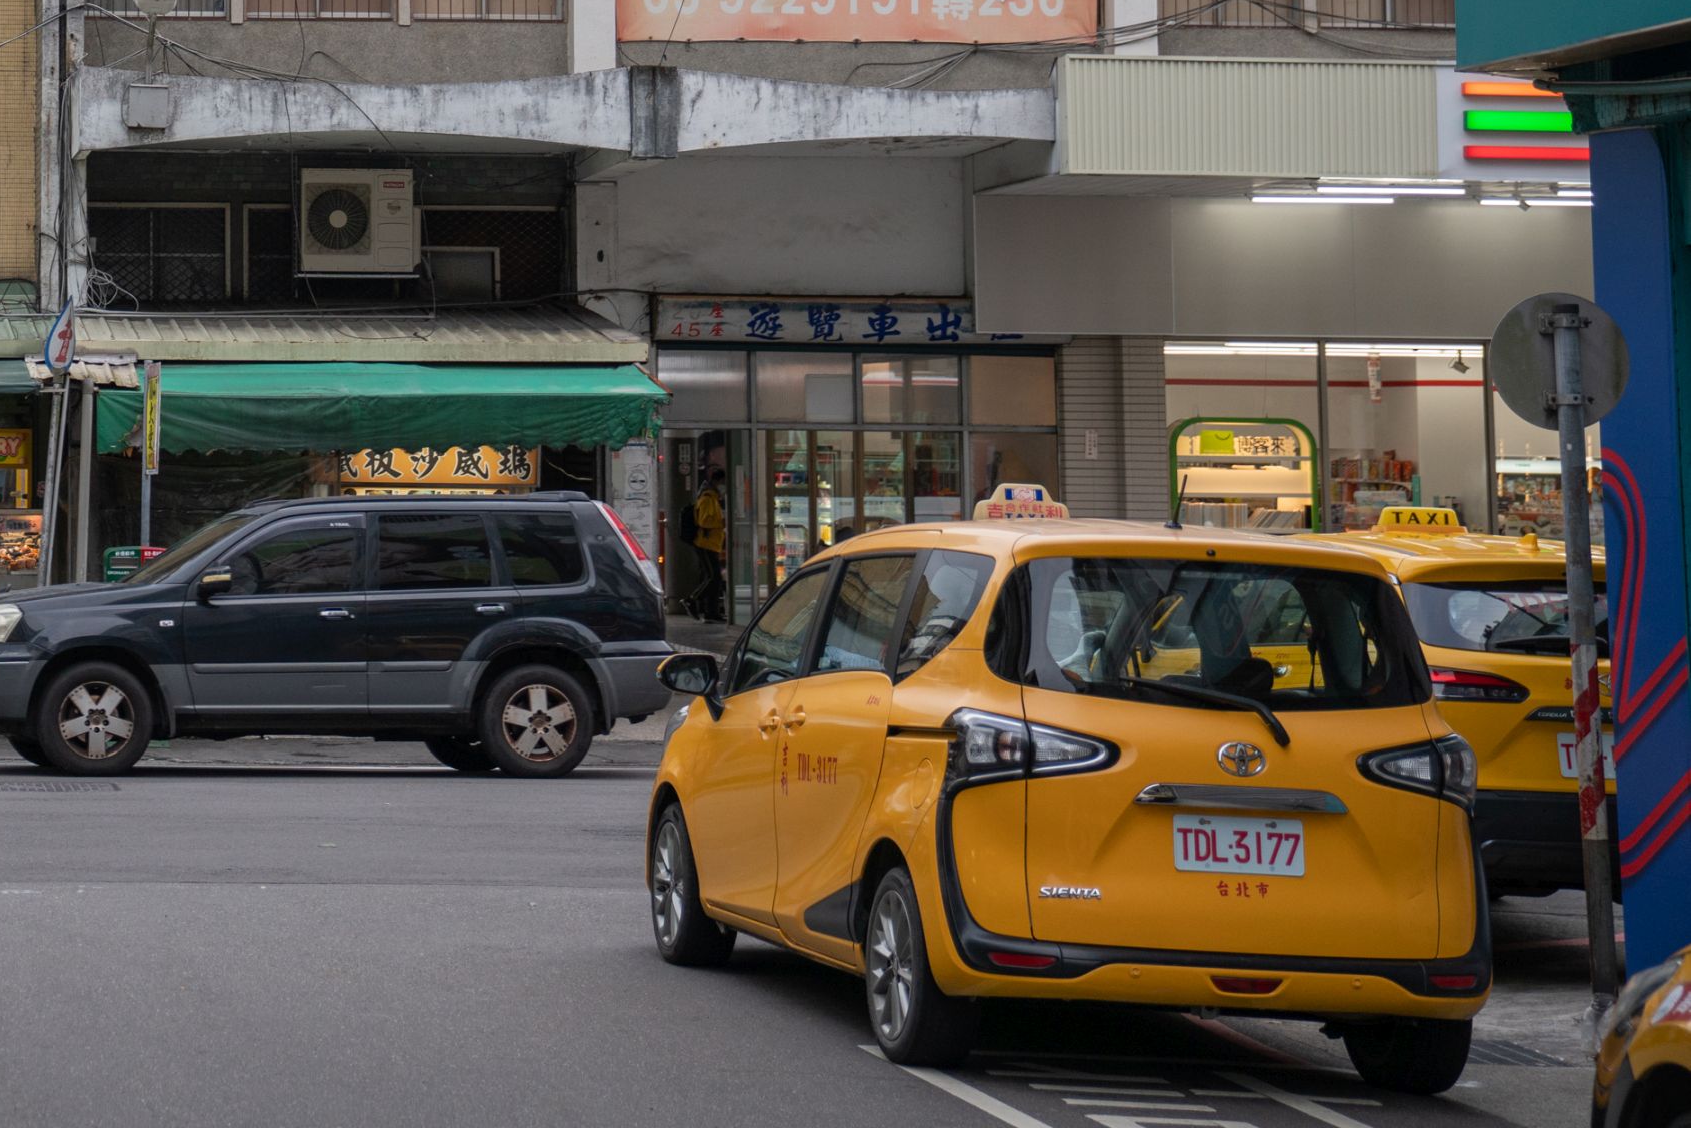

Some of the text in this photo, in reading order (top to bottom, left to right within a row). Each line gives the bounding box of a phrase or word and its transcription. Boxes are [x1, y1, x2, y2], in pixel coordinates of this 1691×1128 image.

[745, 302, 1023, 342] 遊覽車出
[1392, 511, 1450, 525] TAXI
[1039, 886, 1102, 900] SIENTA
[1216, 880, 1270, 899] 台北市
